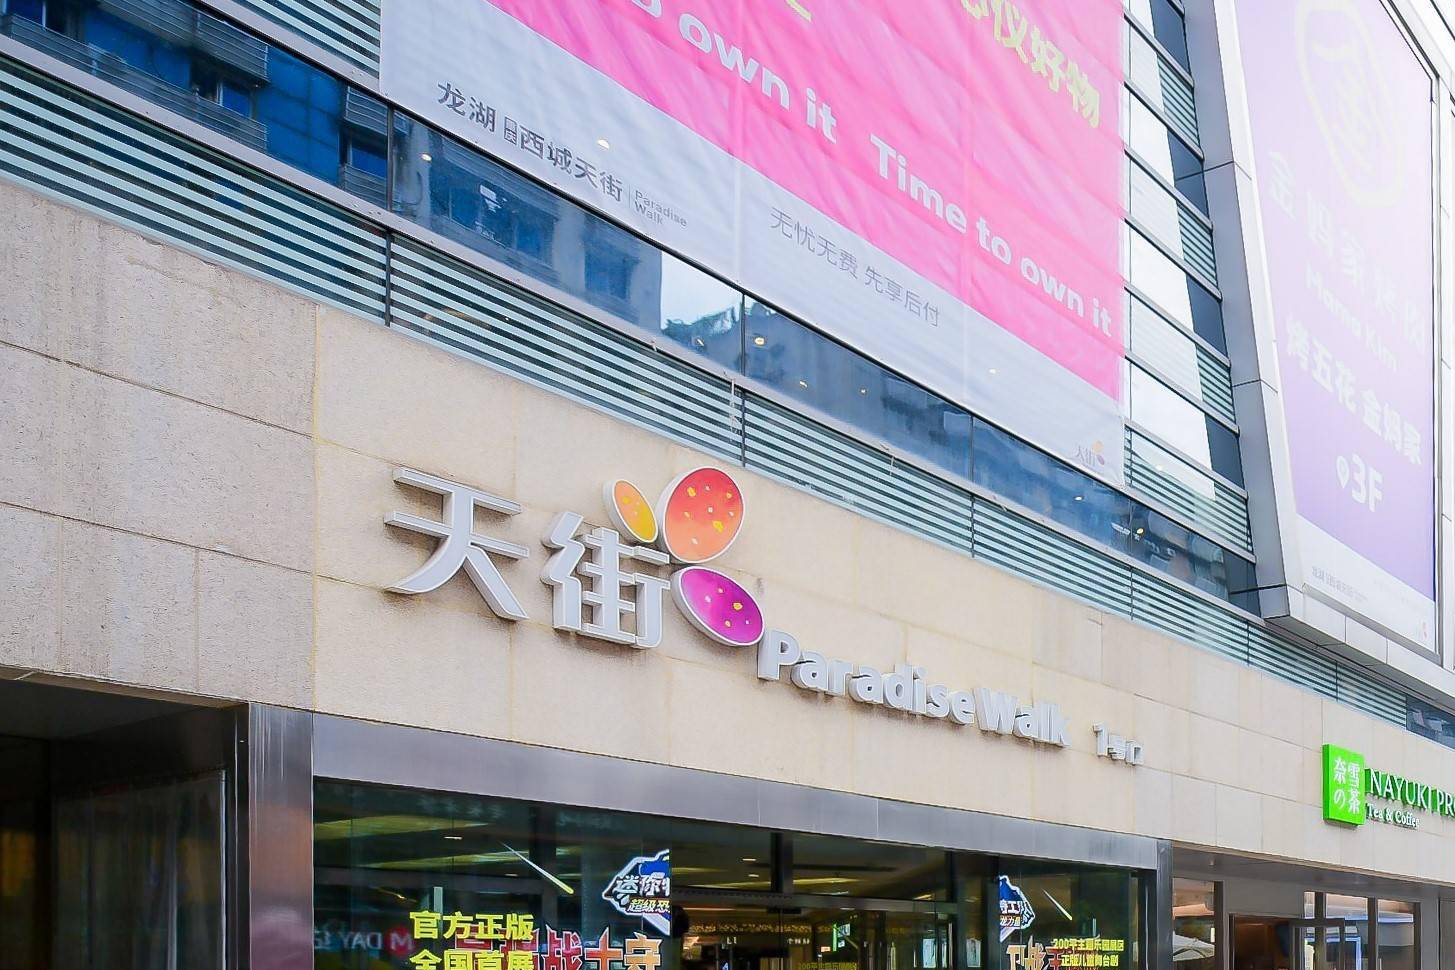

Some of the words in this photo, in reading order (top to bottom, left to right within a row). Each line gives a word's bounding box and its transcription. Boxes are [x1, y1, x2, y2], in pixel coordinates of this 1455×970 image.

[962, 0, 1100, 128] 仪好物
[437, 81, 496, 132] 龙湖
[520, 124, 623, 202] 西城天街
[679, 13, 790, 111] own
[806, 88, 837, 144] it
[870, 133, 967, 234] Time
[975, 216, 1012, 266] to
[1020, 256, 1085, 318] own
[1092, 297, 1112, 338] it
[769, 206, 857, 282] 无忧无费
[864, 265, 940, 328] 先享后付
[1352, 452, 1384, 513] 3F
[384, 467, 670, 649] 天街
[1367, 803, 1384, 818] Tea
[1395, 811, 1420, 829] Coffee
[1370, 769, 1433, 813] NAYUKI
[409, 911, 534, 940] 官方正版
